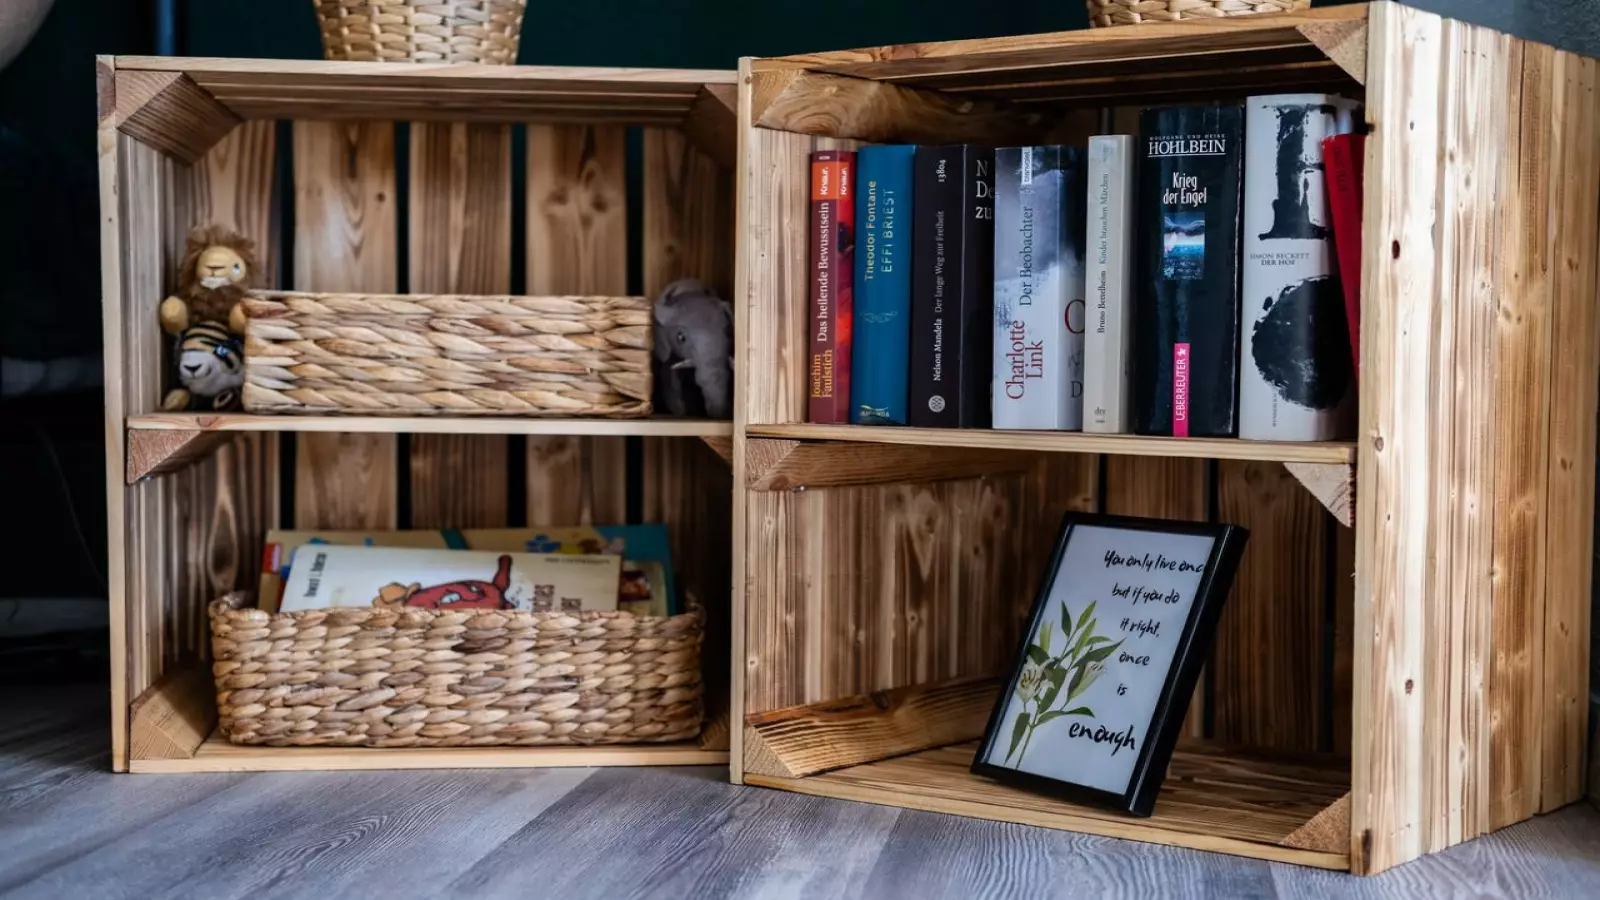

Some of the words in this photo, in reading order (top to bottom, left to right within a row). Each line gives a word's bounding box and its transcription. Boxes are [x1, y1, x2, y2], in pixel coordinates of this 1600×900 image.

[1148, 139, 1226, 155] HOHLBEIN
[936, 160, 947, 182] 13804
[1172, 172, 1198, 191] Krieg
[1100, 173, 1109, 205] Märchen
[1164, 187, 1177, 204] der
[1180, 187, 1207, 206] Engel
[866, 180, 878, 229] Fontane
[884, 190, 894, 238] BRIEST
[819, 203, 829, 269] Bewusstsein
[935, 211, 945, 242] Freiheit
[1100, 207, 1108, 238] brauchen
[864, 232, 876, 280] Theodor
[1020, 206, 1033, 278] Beobachter
[1098, 240, 1107, 265] Kinder
[882, 244, 894, 272] EFFI
[935, 256, 945, 275] Weg
[816, 271, 828, 318] heilende
[934, 276, 945, 297] lange
[1020, 282, 1032, 307] Der
[1097, 270, 1106, 309] Bettelheim
[816, 321, 828, 342] Das
[934, 318, 942, 352] Mandela
[1097, 311, 1106, 334] Bruno
[822, 349, 832, 398] Faulstich
[932, 353, 941, 381] Nelson
[1005, 320, 1025, 400] Charlotte
[1026, 340, 1044, 379] Link
[811, 354, 821, 398] Joachim
[1175, 358, 1185, 421] UEBERREUTER
[1104, 550, 1125, 569] You
[1126, 554, 1153, 572] only
[1155, 555, 1176, 571] live
[1112, 586, 1130, 600] but
[1131, 587, 1142, 605] if
[1143, 590, 1164, 604] you
[1165, 591, 1180, 604] do
[1120, 618, 1130, 630] it
[1130, 619, 1160, 638] right,
[1118, 652, 1150, 666] once
[1117, 682, 1128, 695] is
[1068, 722, 1136, 756] enough
